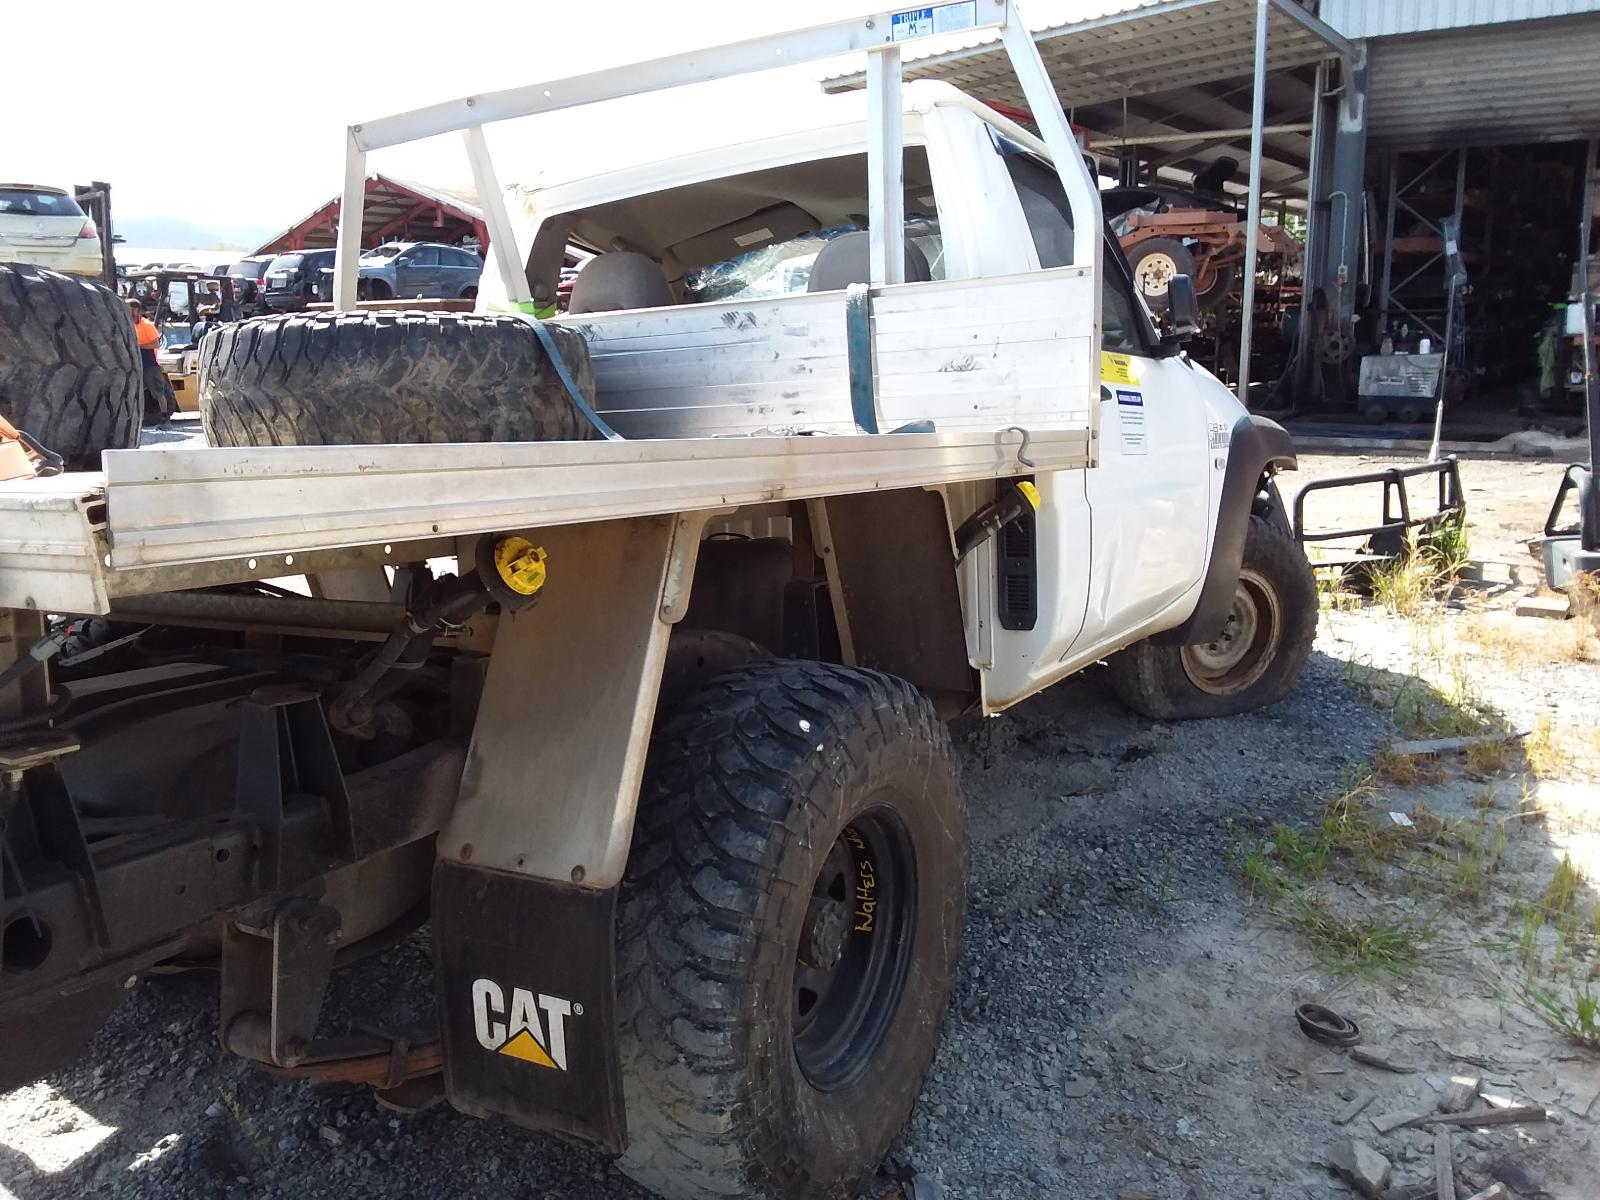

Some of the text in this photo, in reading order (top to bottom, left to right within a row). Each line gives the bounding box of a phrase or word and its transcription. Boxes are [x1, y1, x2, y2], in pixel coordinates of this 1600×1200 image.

[898, 9, 928, 24] TRIPLE
[908, 22, 918, 35] M
[472, 978, 571, 1071] CAT
